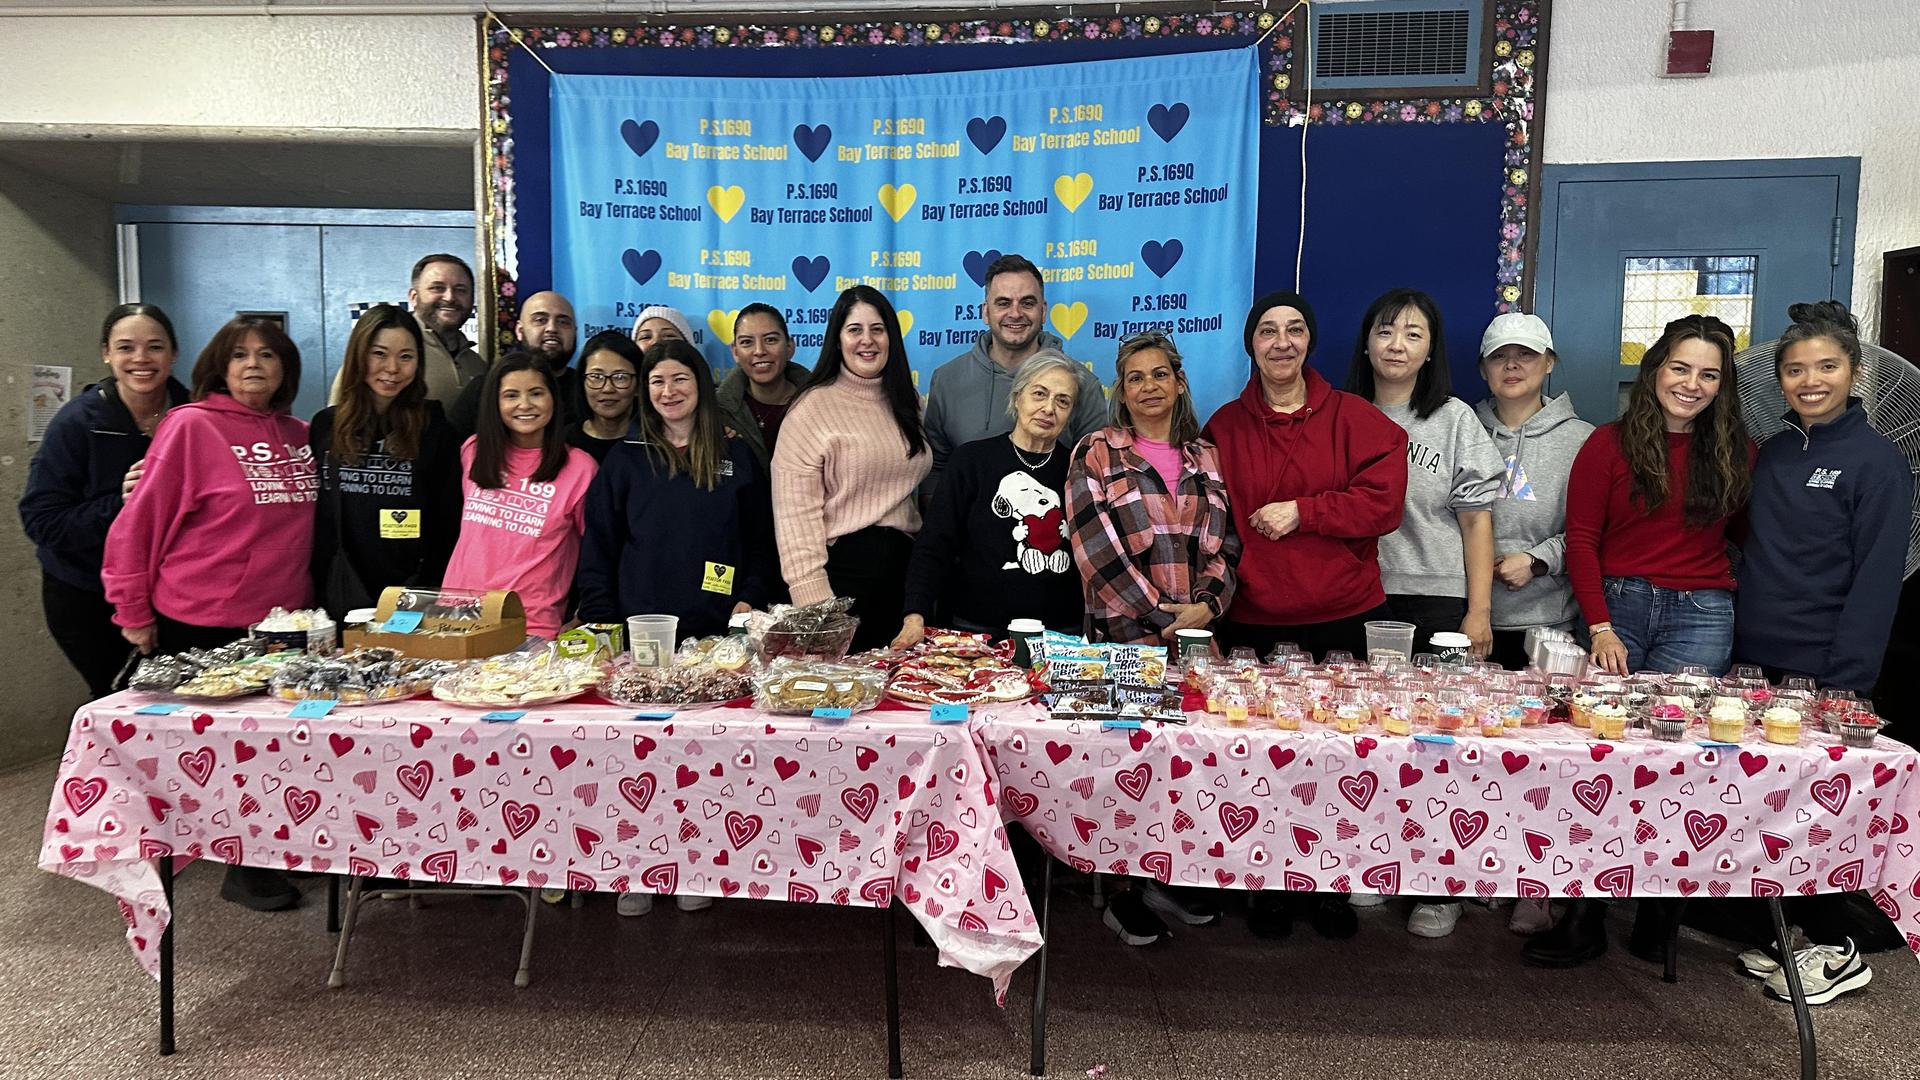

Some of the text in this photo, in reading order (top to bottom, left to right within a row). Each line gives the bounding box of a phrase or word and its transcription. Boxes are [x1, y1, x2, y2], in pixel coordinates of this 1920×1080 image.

[1048, 104, 1103, 124] P.S.169Q
[700, 118, 752, 136] P.S.169Q
[872, 118, 925, 136] P.S.169Q
[1012, 127, 1140, 152] Bay Terrace School
[666, 142, 788, 161] Bay Terrace School
[837, 140, 960, 164] Bay Terrace School
[1138, 162, 1194, 183] P.S.169Q
[614, 178, 667, 197] P.S.169Q
[786, 183, 838, 200] P.S.169Q
[958, 176, 1012, 194] P.S.169Q
[1099, 184, 1228, 212] Bay Terrace School
[580, 201, 701, 222] Bay Terrace School
[751, 206, 872, 226] Bay Terrace School
[922, 198, 1048, 222] Bay Terrace School
[700, 249, 751, 267] P.S.169Q
[1046, 240, 1097, 258] P.S.169Q
[871, 250, 921, 268] P.S.169Q
[1087, 262, 1134, 280] School
[668, 272, 786, 290] Bay Terrace School
[862, 275, 909, 291] Terrace
[912, 273, 956, 290] School
[1132, 293, 1187, 312] P.S.169Q
[955, 304, 983, 320] P.S.1
[1094, 322, 1118, 339] Bay
[1178, 314, 1222, 334] School
[920, 330, 942, 347] Bay
[378, 474, 412, 485] LEARN
[520, 478, 555, 498] 169
[387, 486, 412, 496] LOVE
[499, 509, 512, 520] TO
[514, 513, 545, 527] LEARN
[505, 522, 518, 531] TO
[519, 525, 542, 538] LOVE
[1120, 660, 1146, 670] Bites
